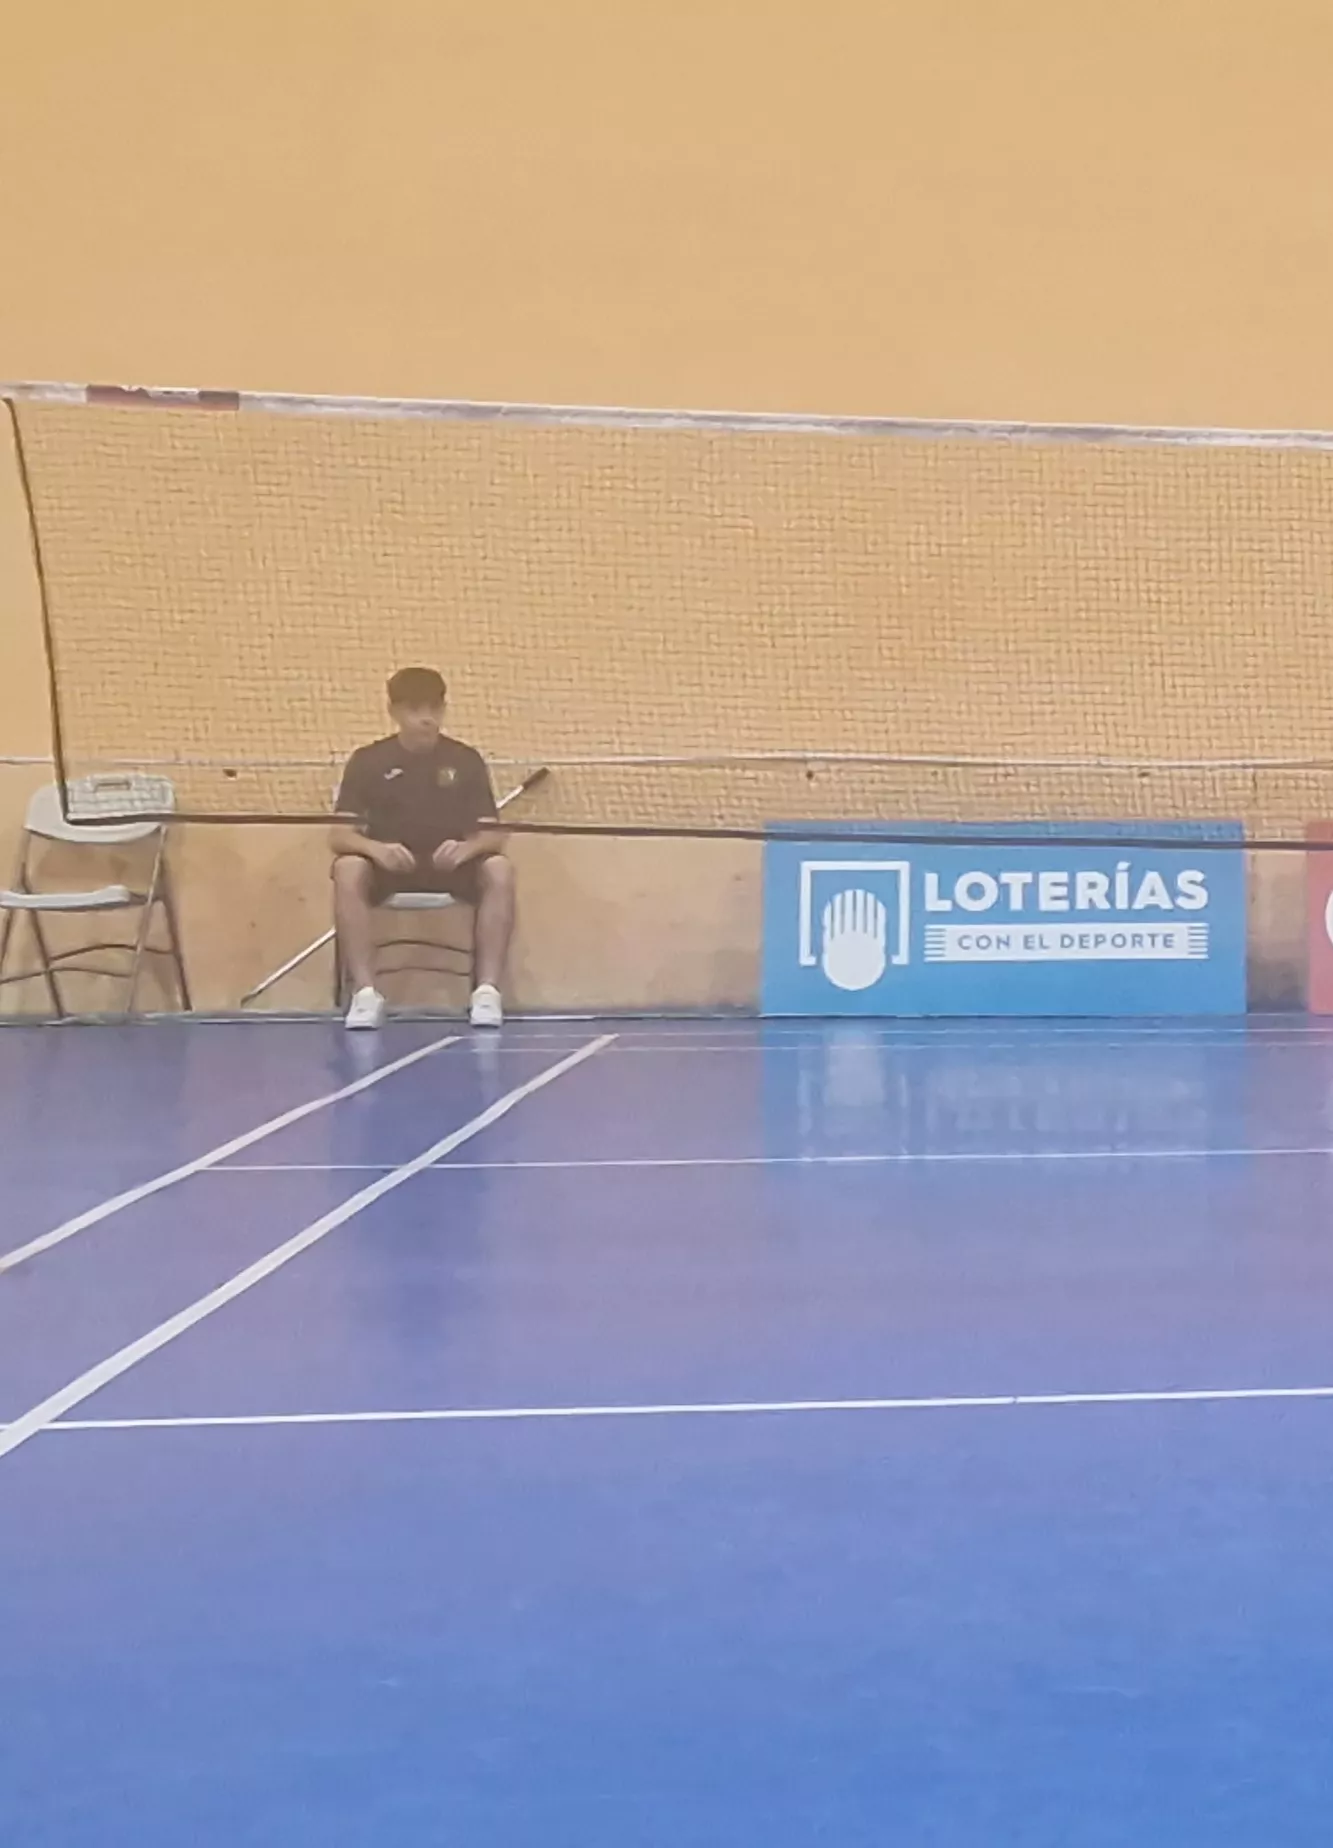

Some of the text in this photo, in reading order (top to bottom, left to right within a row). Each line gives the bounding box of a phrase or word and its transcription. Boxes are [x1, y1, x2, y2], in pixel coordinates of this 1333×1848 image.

[924, 861, 1209, 912] LOTERÍAS
[957, 932, 1175, 950] CON EL DEPORTE
